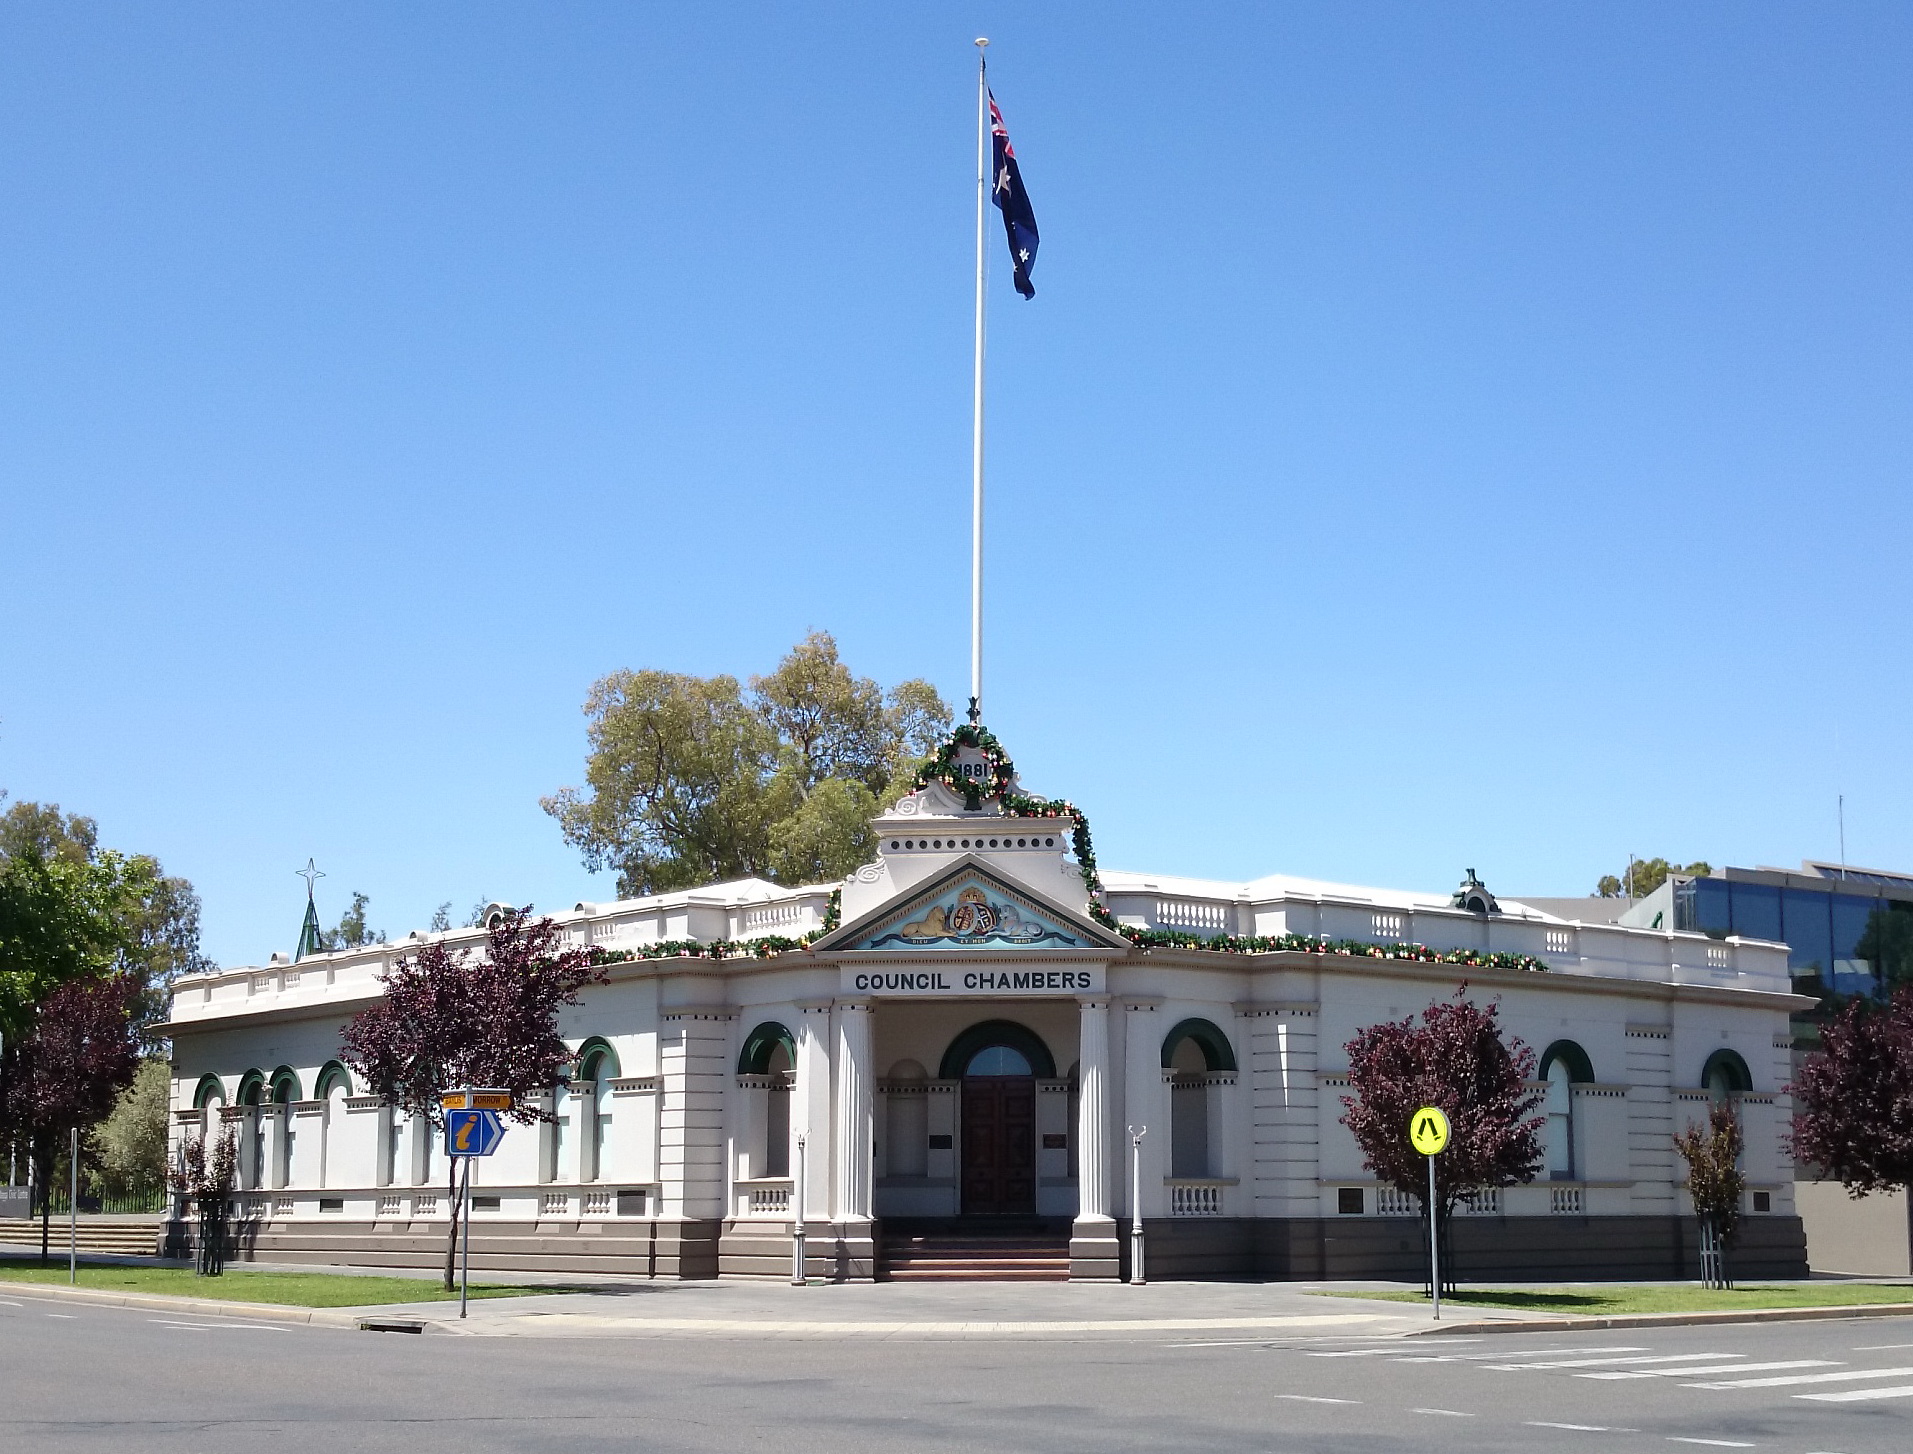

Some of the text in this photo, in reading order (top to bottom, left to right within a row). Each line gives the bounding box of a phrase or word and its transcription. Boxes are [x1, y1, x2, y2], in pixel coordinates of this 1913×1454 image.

[957, 764, 988, 777] 1881
[855, 972, 1091, 990] COUNCIL CHAMBERS
